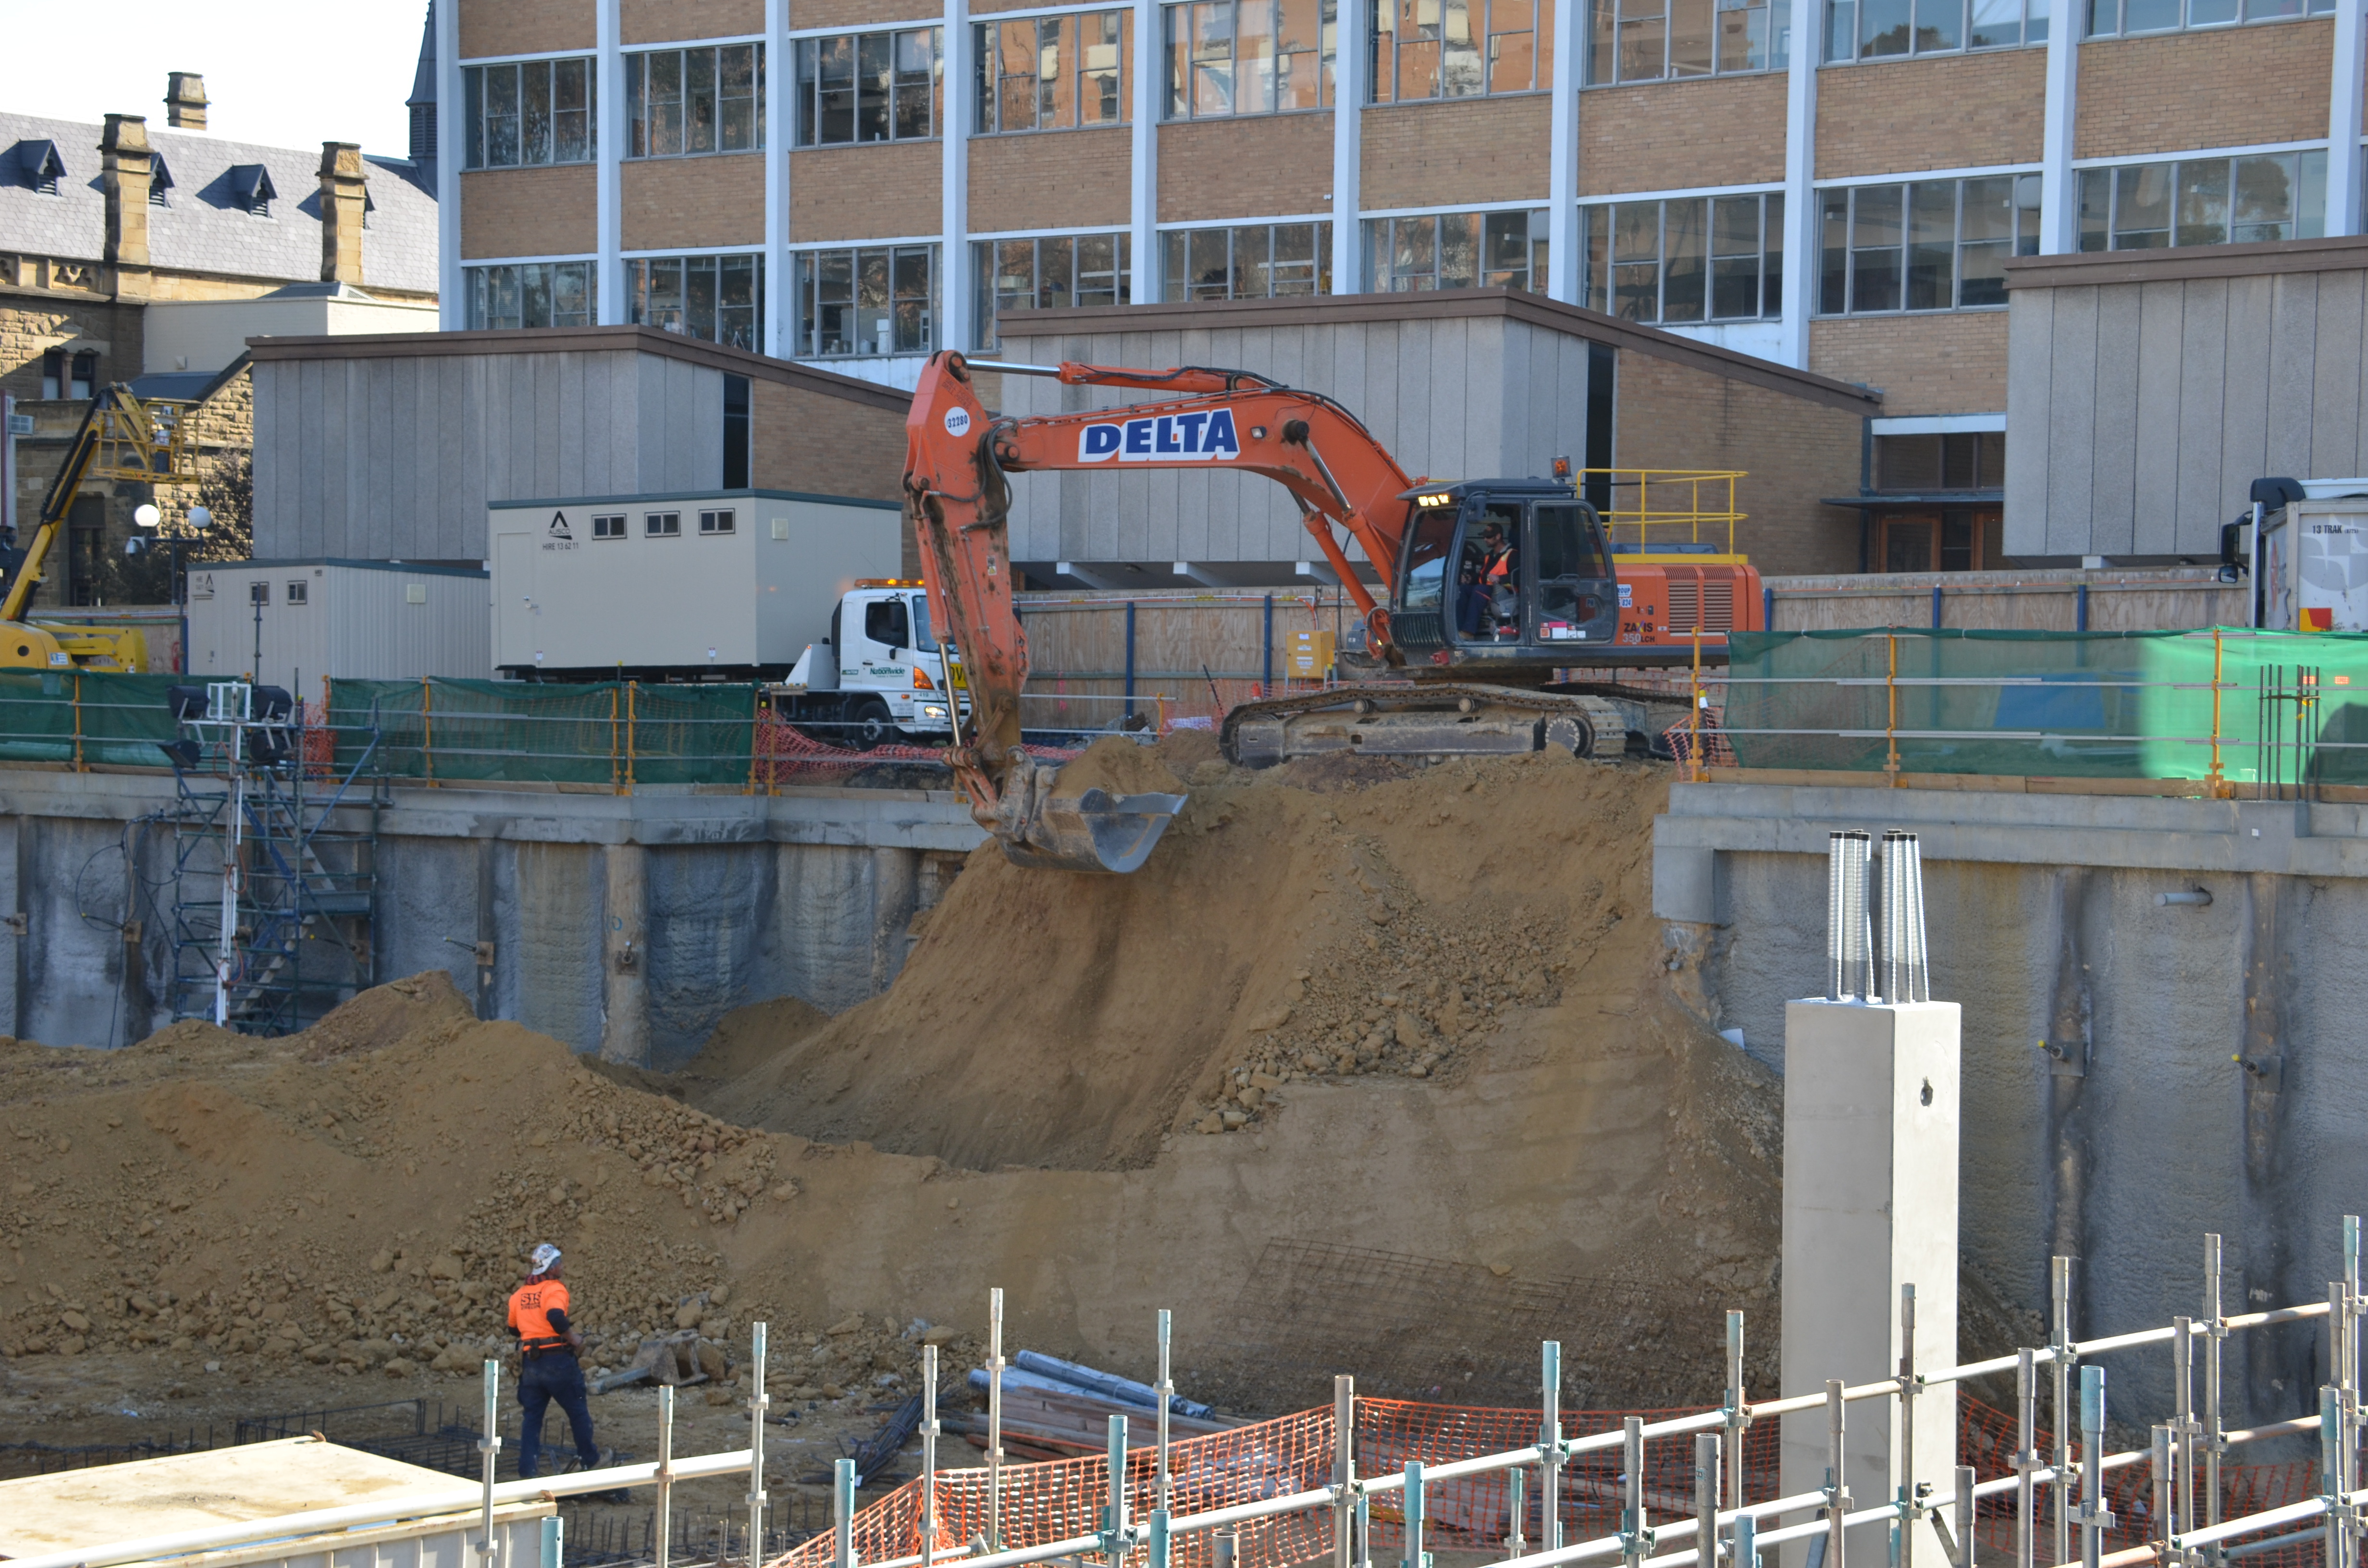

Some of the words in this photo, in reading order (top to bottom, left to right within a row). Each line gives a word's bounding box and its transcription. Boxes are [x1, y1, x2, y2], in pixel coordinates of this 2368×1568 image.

[947, 415, 968, 428] 32280
[1085, 409, 1239, 454] DELTA
[2312, 525, 2321, 534] 13
[2324, 525, 2342, 534] TRAK
[1624, 621, 1653, 633] ZAXIS
